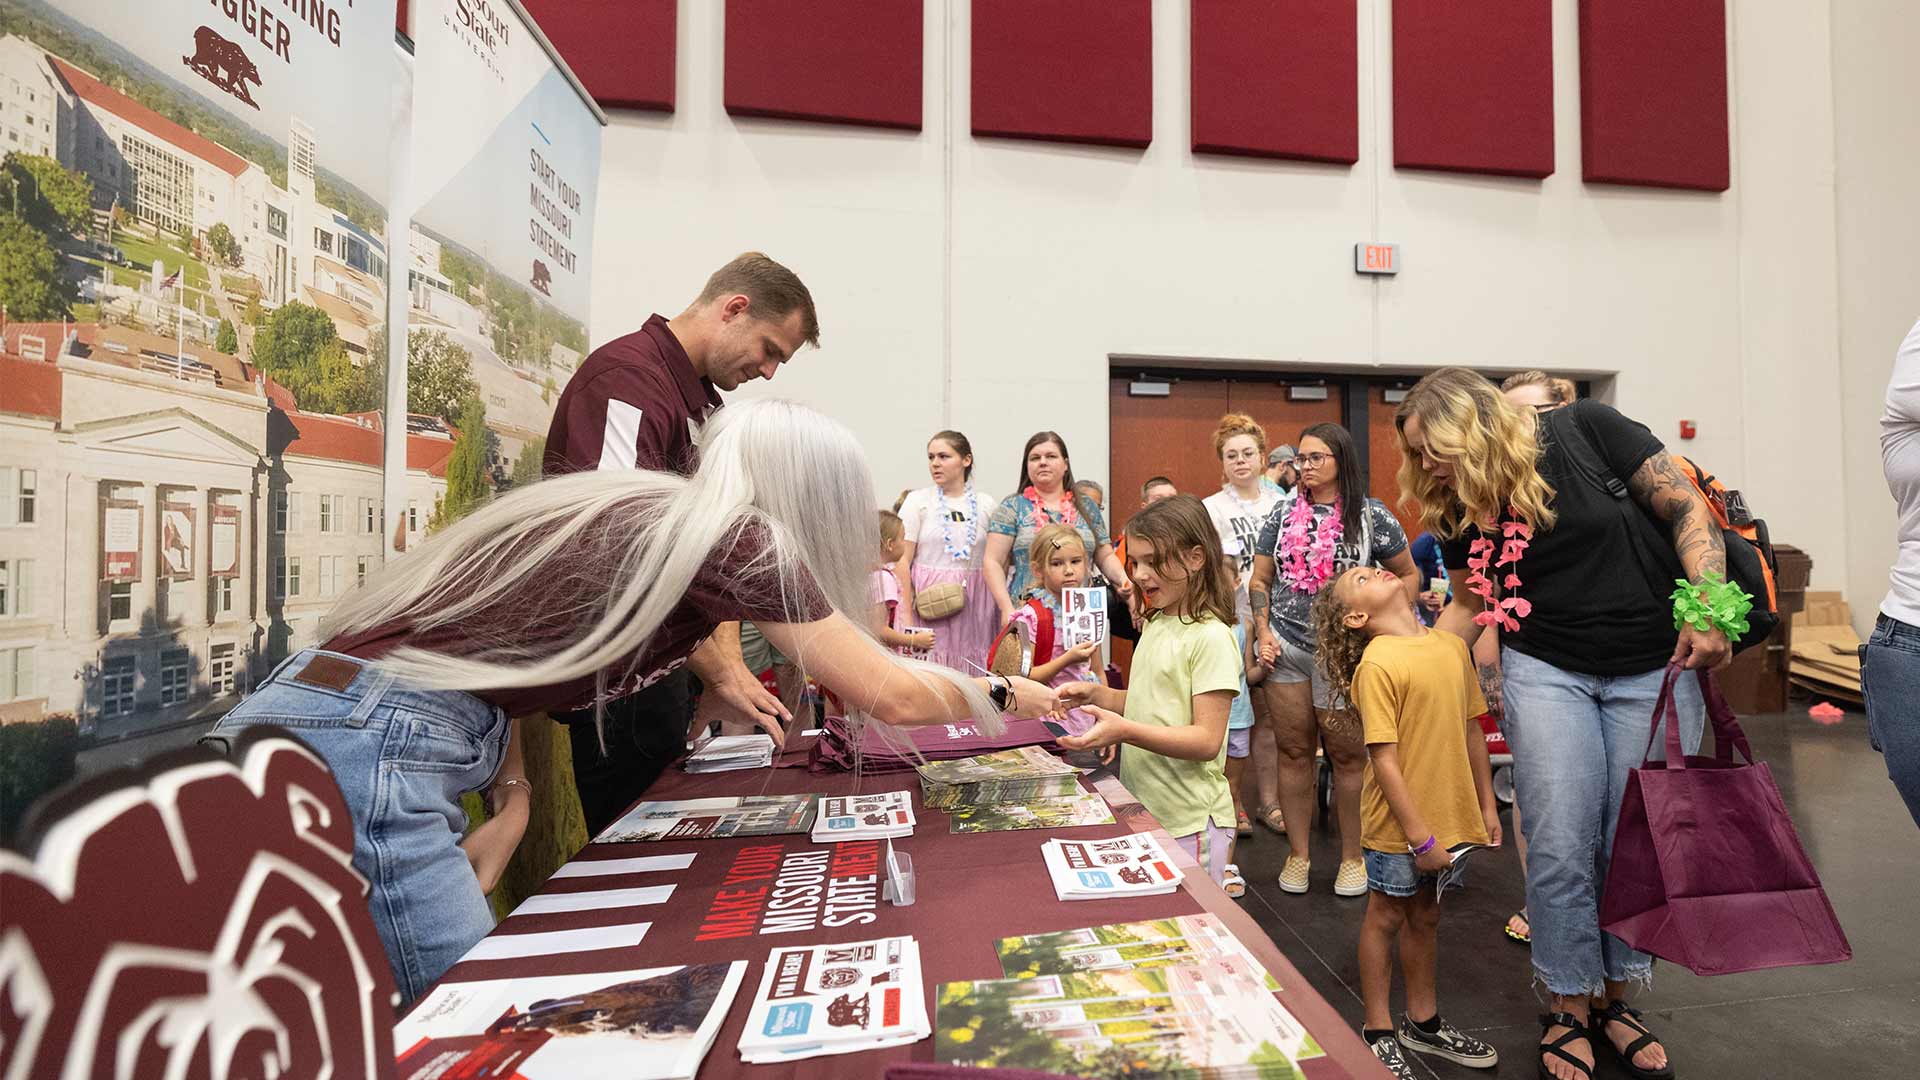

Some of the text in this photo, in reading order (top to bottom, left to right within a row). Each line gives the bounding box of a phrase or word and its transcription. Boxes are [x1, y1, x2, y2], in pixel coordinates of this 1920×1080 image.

[456, 0, 496, 55] State
[530, 148, 582, 216] START YOUR
[530, 182, 572, 241] MISSOURI
[530, 218, 577, 275] STATEMENT
[1365, 245, 1393, 269] EXIT
[694, 843, 785, 941] MAKE YOUR
[759, 850, 830, 935] MISSOURI
[822, 840, 879, 927] STATEMENT
